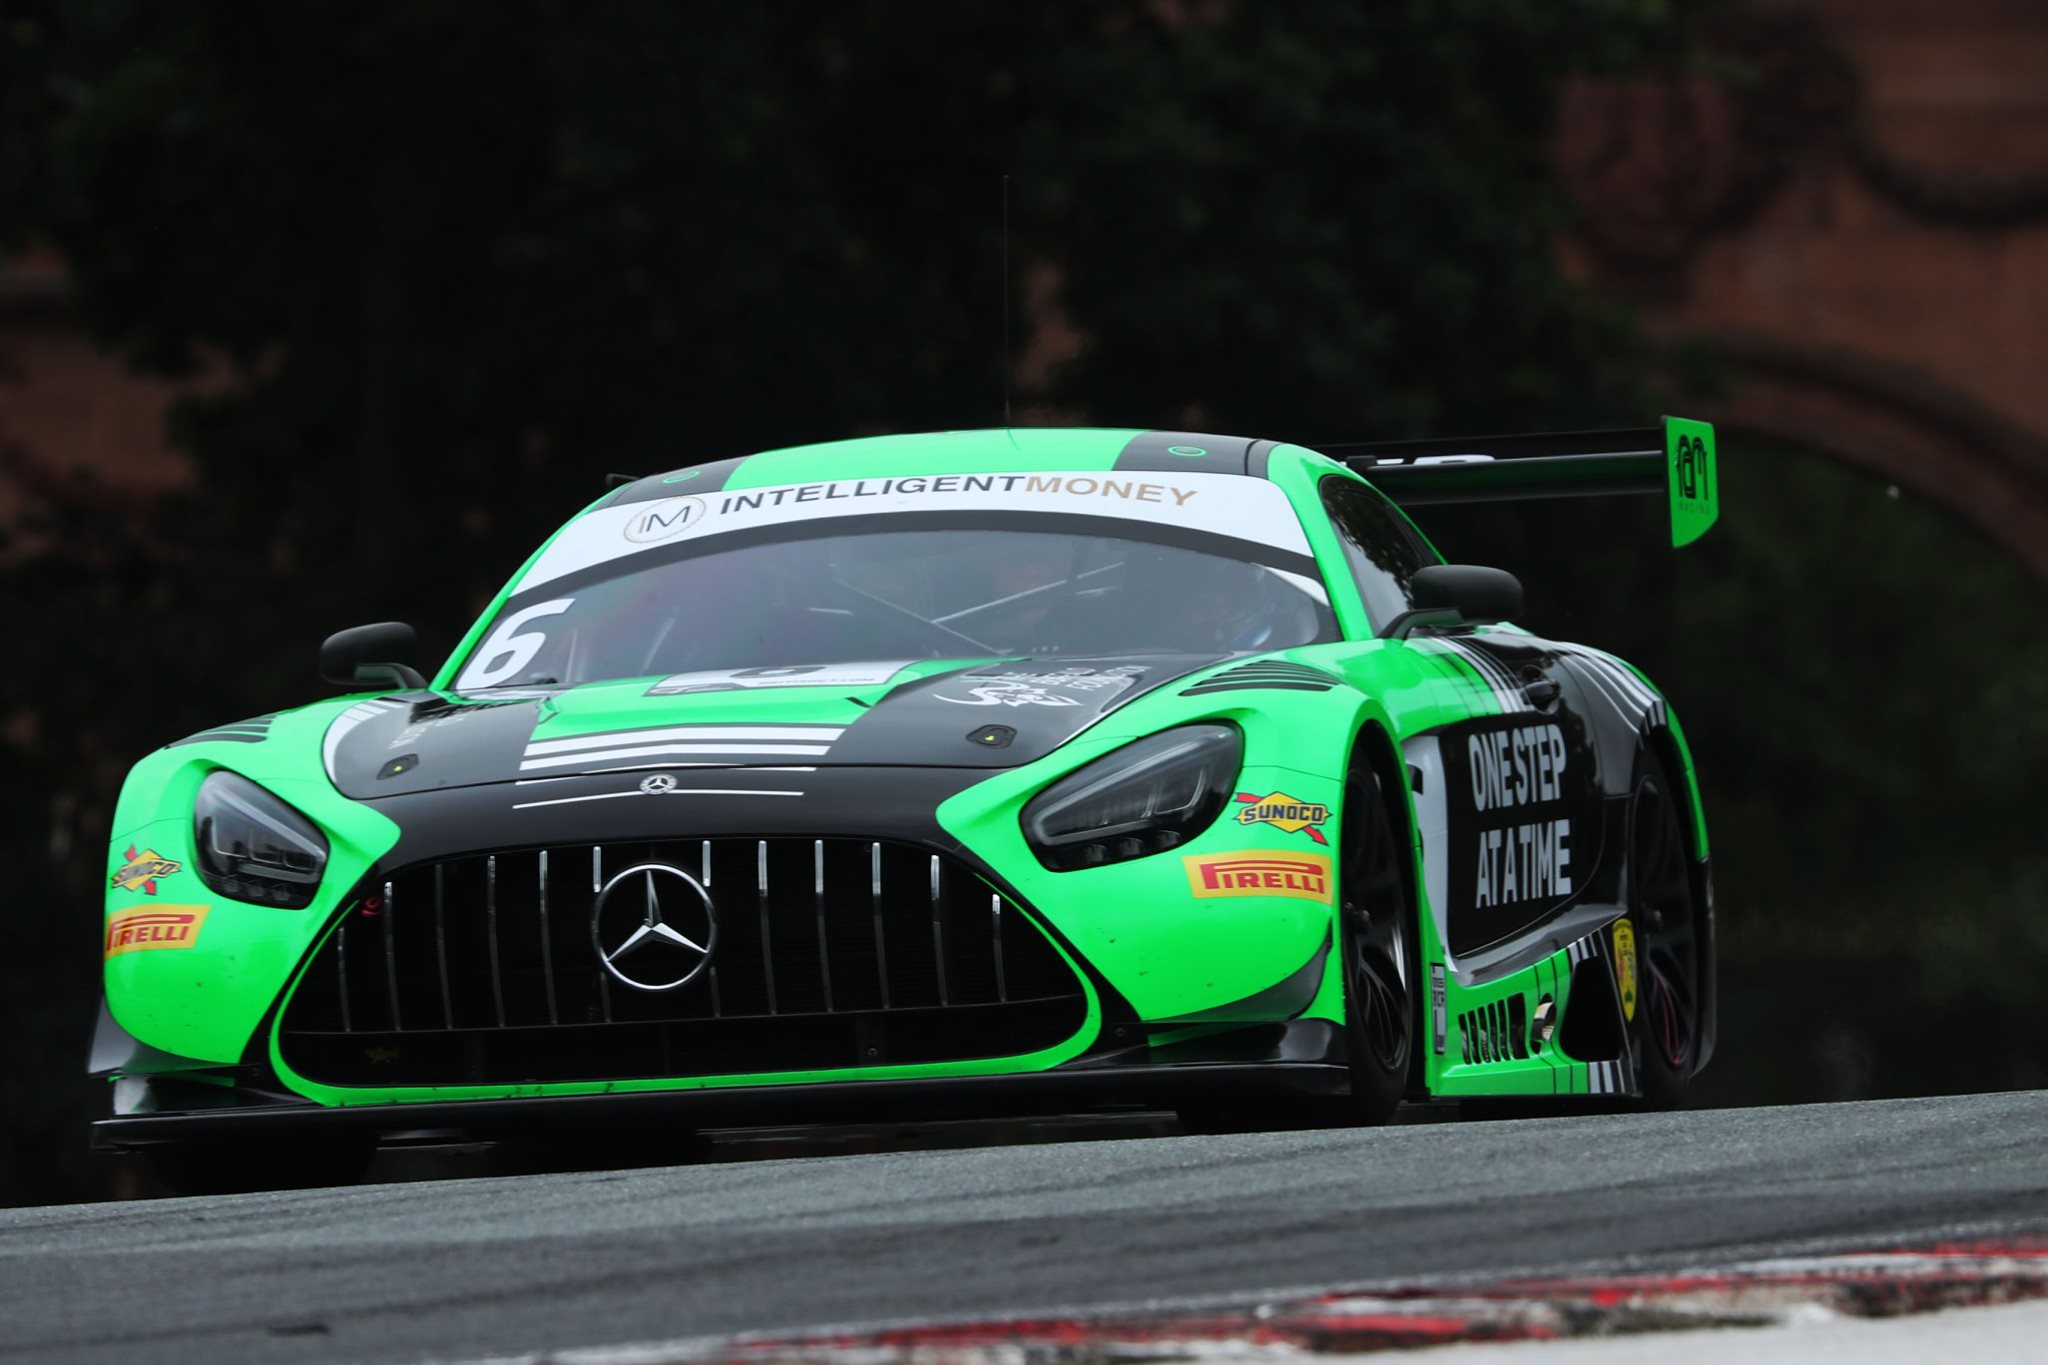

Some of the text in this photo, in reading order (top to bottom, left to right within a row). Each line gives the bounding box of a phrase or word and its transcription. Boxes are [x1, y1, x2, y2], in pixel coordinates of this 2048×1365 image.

[456, 598, 576, 690] 6
[1243, 804, 1324, 822] SUNOCO
[1198, 860, 1325, 894] PIRELLI
[107, 914, 195, 951] PIRELLI
